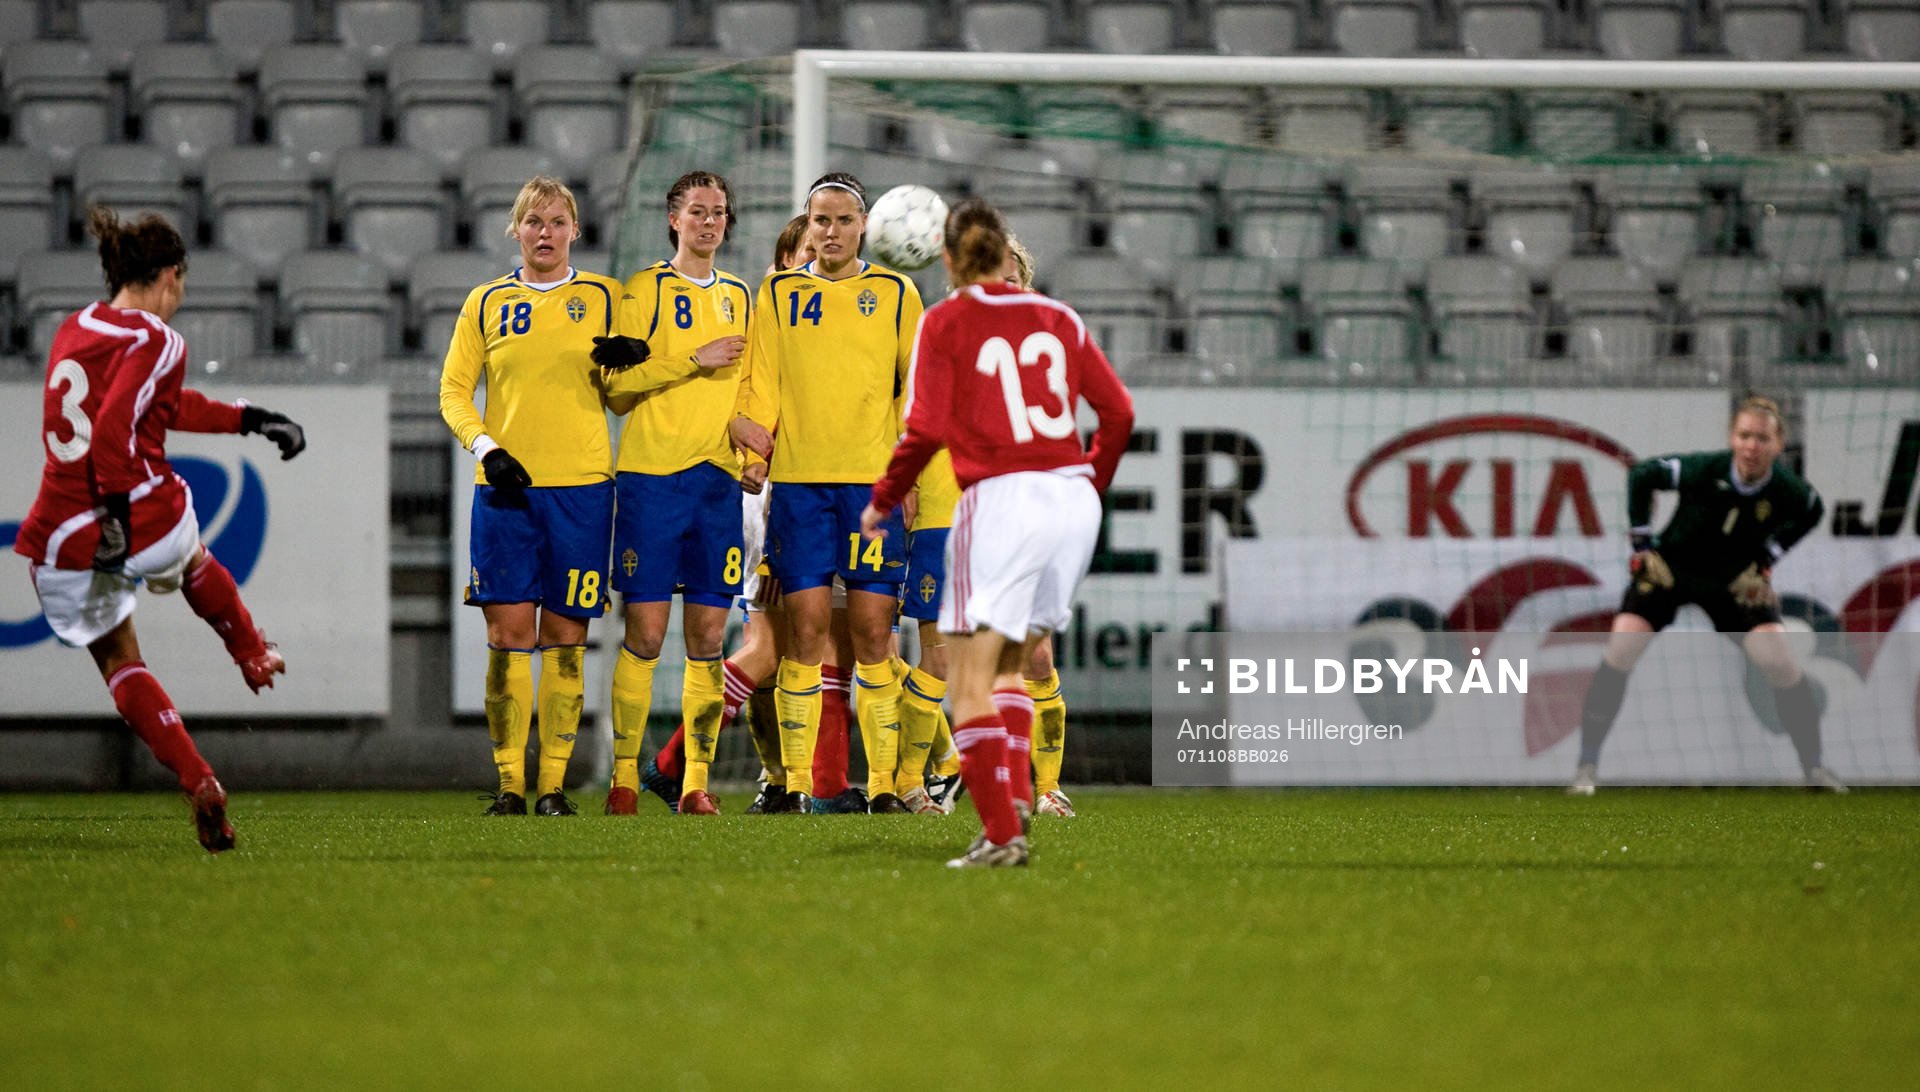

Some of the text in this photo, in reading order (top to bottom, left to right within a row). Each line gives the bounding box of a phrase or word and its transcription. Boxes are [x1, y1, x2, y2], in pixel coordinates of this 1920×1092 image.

[500, 302, 533, 337] 18
[674, 294, 693, 330] 8
[788, 291, 823, 327] 14
[975, 331, 1076, 444] 13
[46, 358, 93, 464] 3
[1406, 457, 1604, 539] KIA
[723, 546, 742, 586] 8
[848, 532, 884, 573] 14
[565, 568, 600, 609] 18
